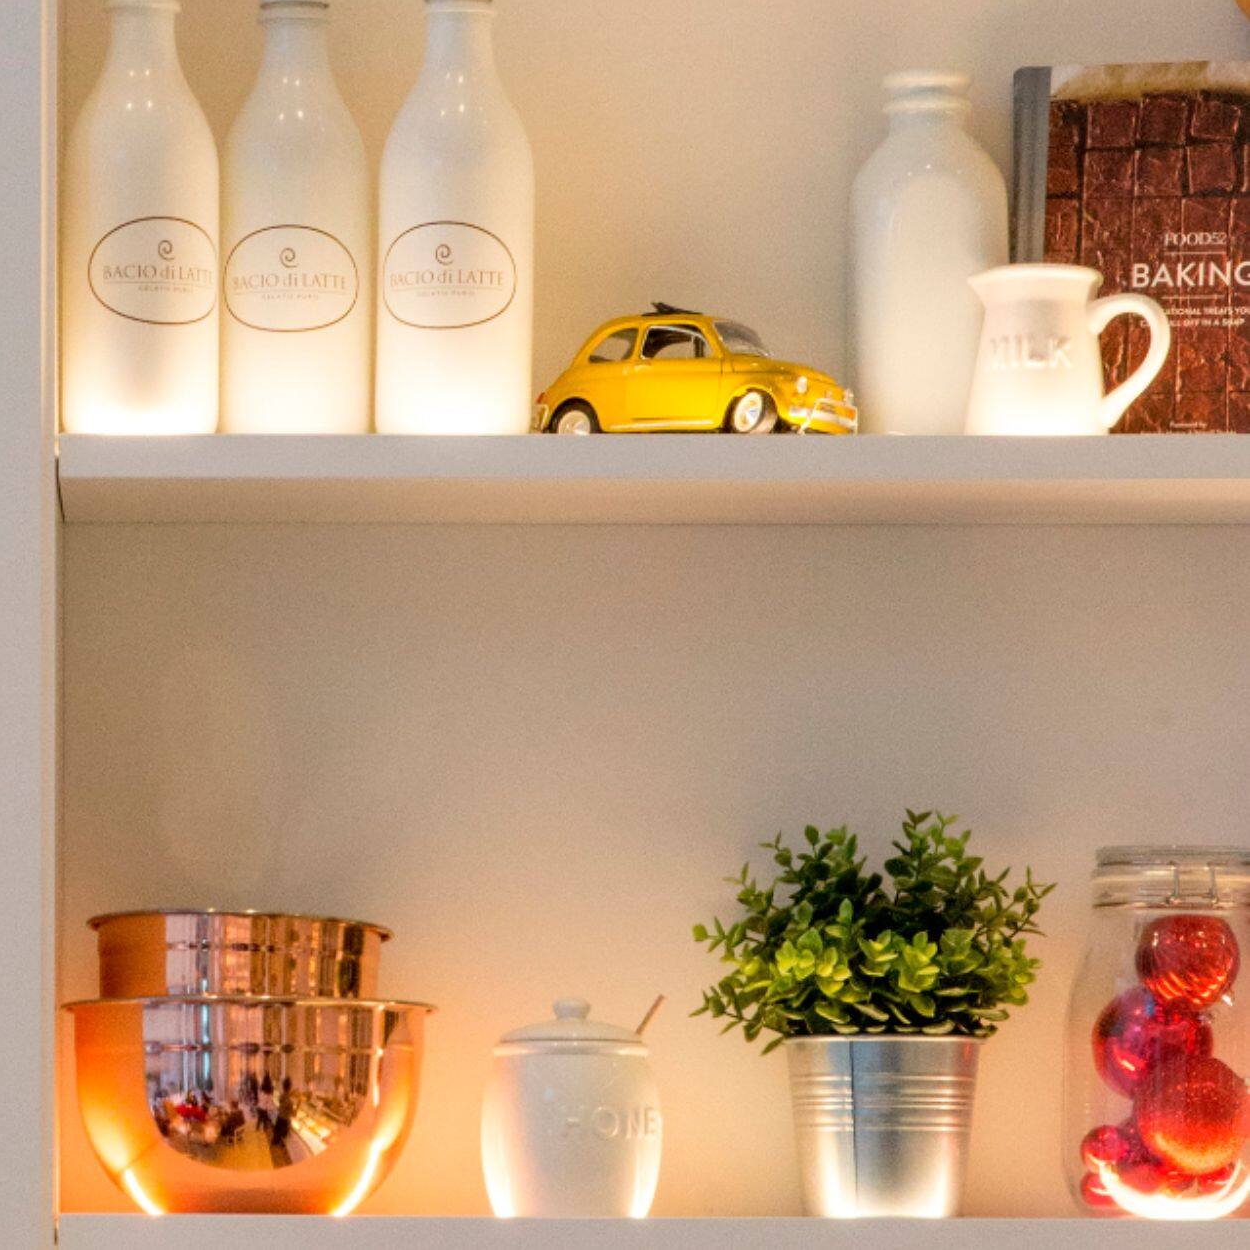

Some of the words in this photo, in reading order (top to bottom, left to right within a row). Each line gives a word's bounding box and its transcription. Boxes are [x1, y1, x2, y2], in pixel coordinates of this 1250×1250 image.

[1163, 232, 1228, 246] FOOD52
[102, 264, 158, 280] BACIO
[159, 264, 175, 280] di
[178, 265, 213, 285] LATTE
[232, 273, 280, 290] BACIO
[282, 273, 298, 287] di
[302, 273, 346, 290] LATTE
[389, 269, 435, 288] BACIO
[436, 269, 453, 284] di
[457, 269, 504, 287] LATTE
[1132, 260, 1250, 288] BAKING
